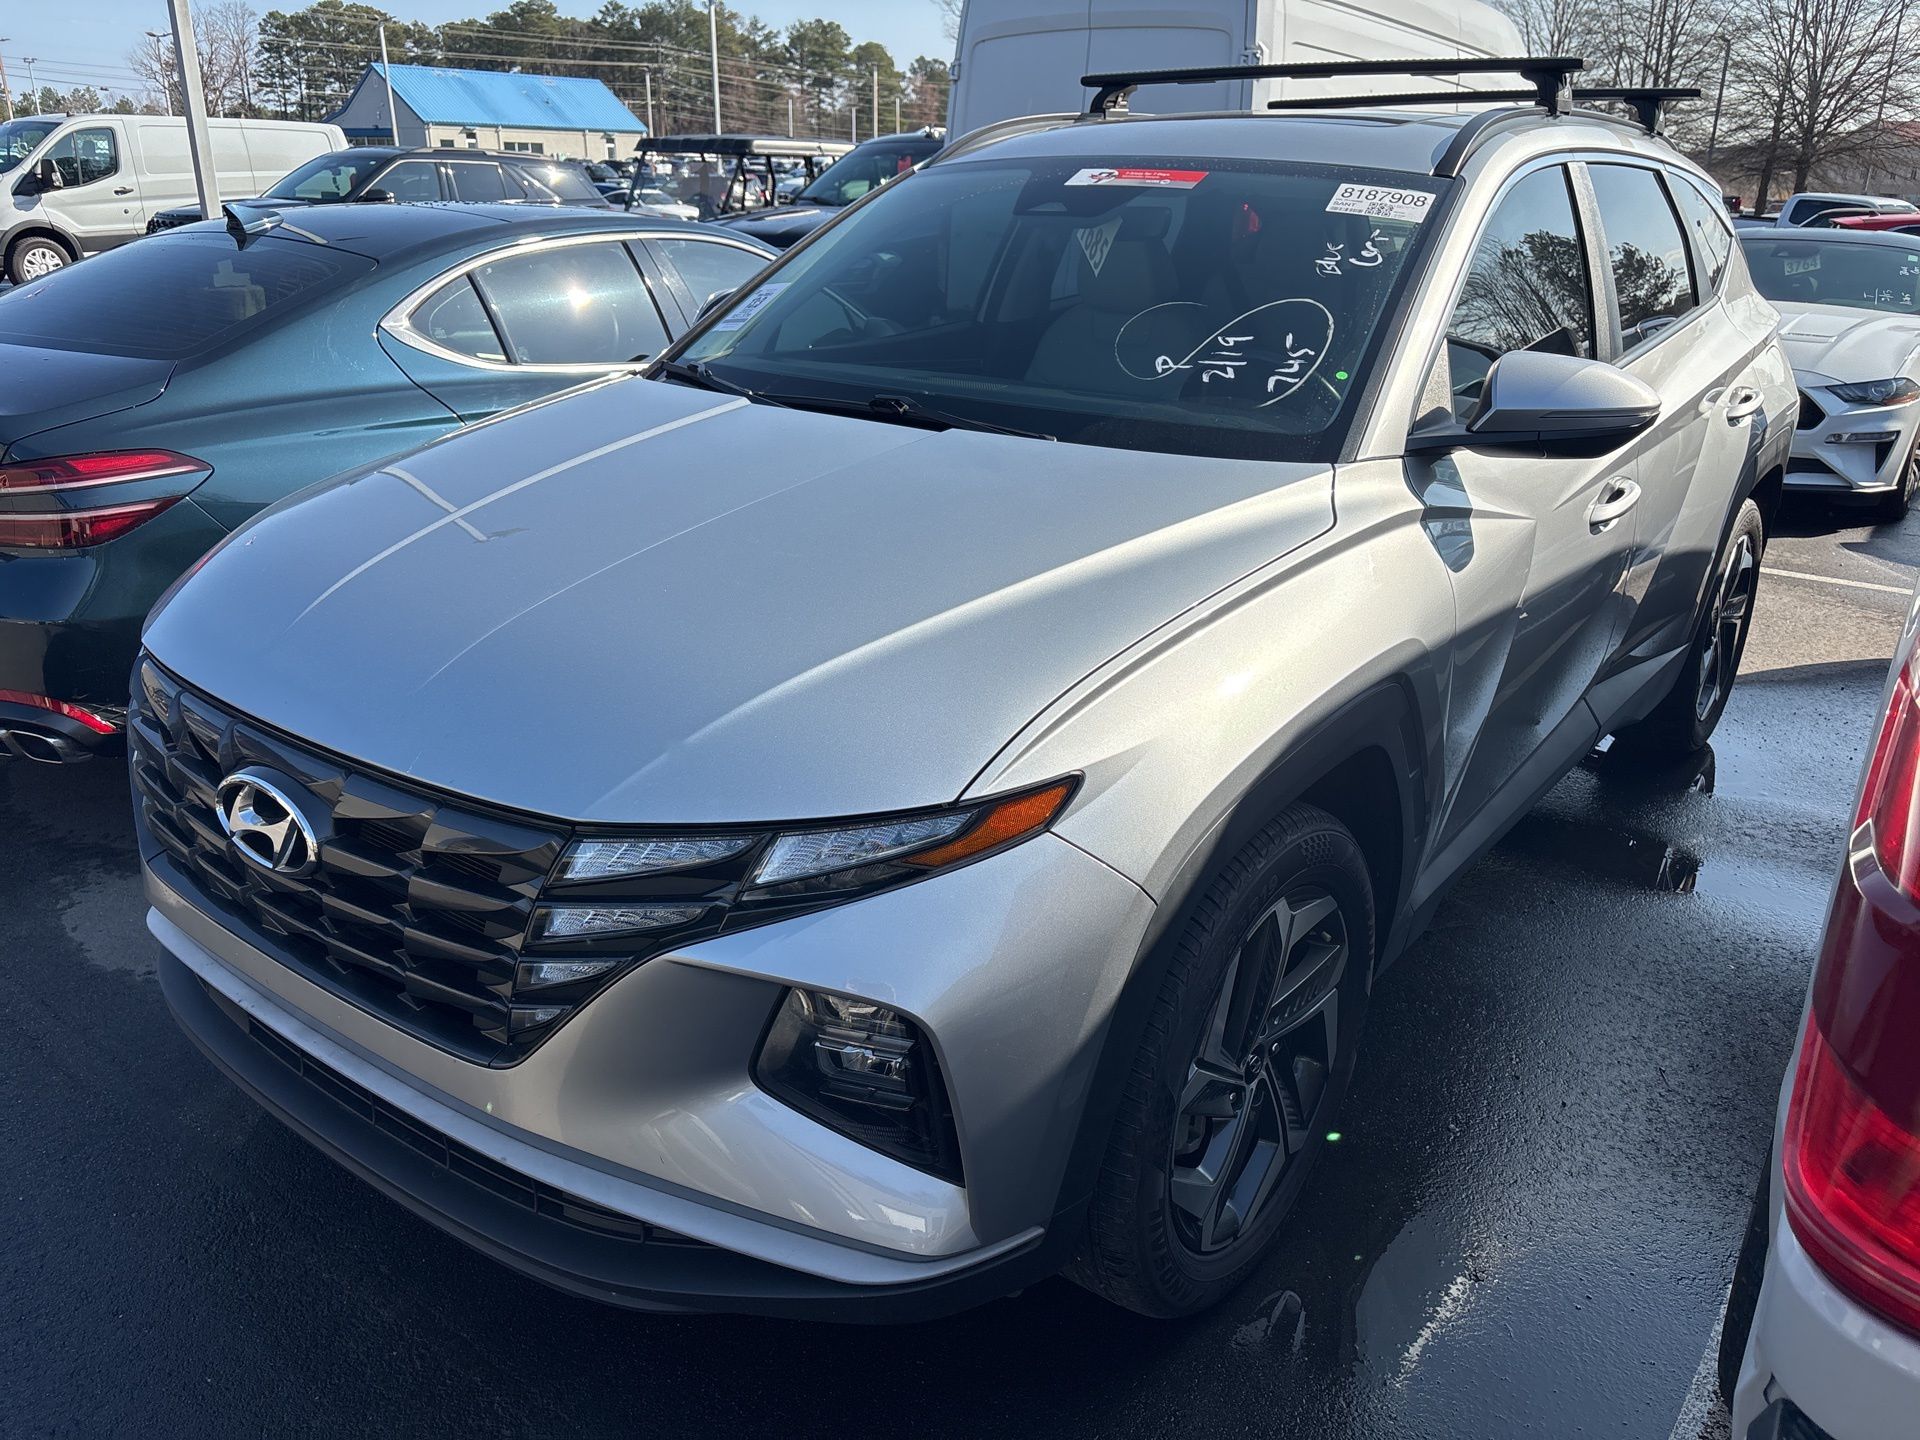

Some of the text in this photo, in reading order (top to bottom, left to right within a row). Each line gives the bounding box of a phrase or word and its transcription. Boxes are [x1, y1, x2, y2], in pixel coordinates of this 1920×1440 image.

[1341, 187, 1428, 207] 8187908
[1198, 335, 1254, 382] 2/19
[1267, 332, 1315, 392] 745
